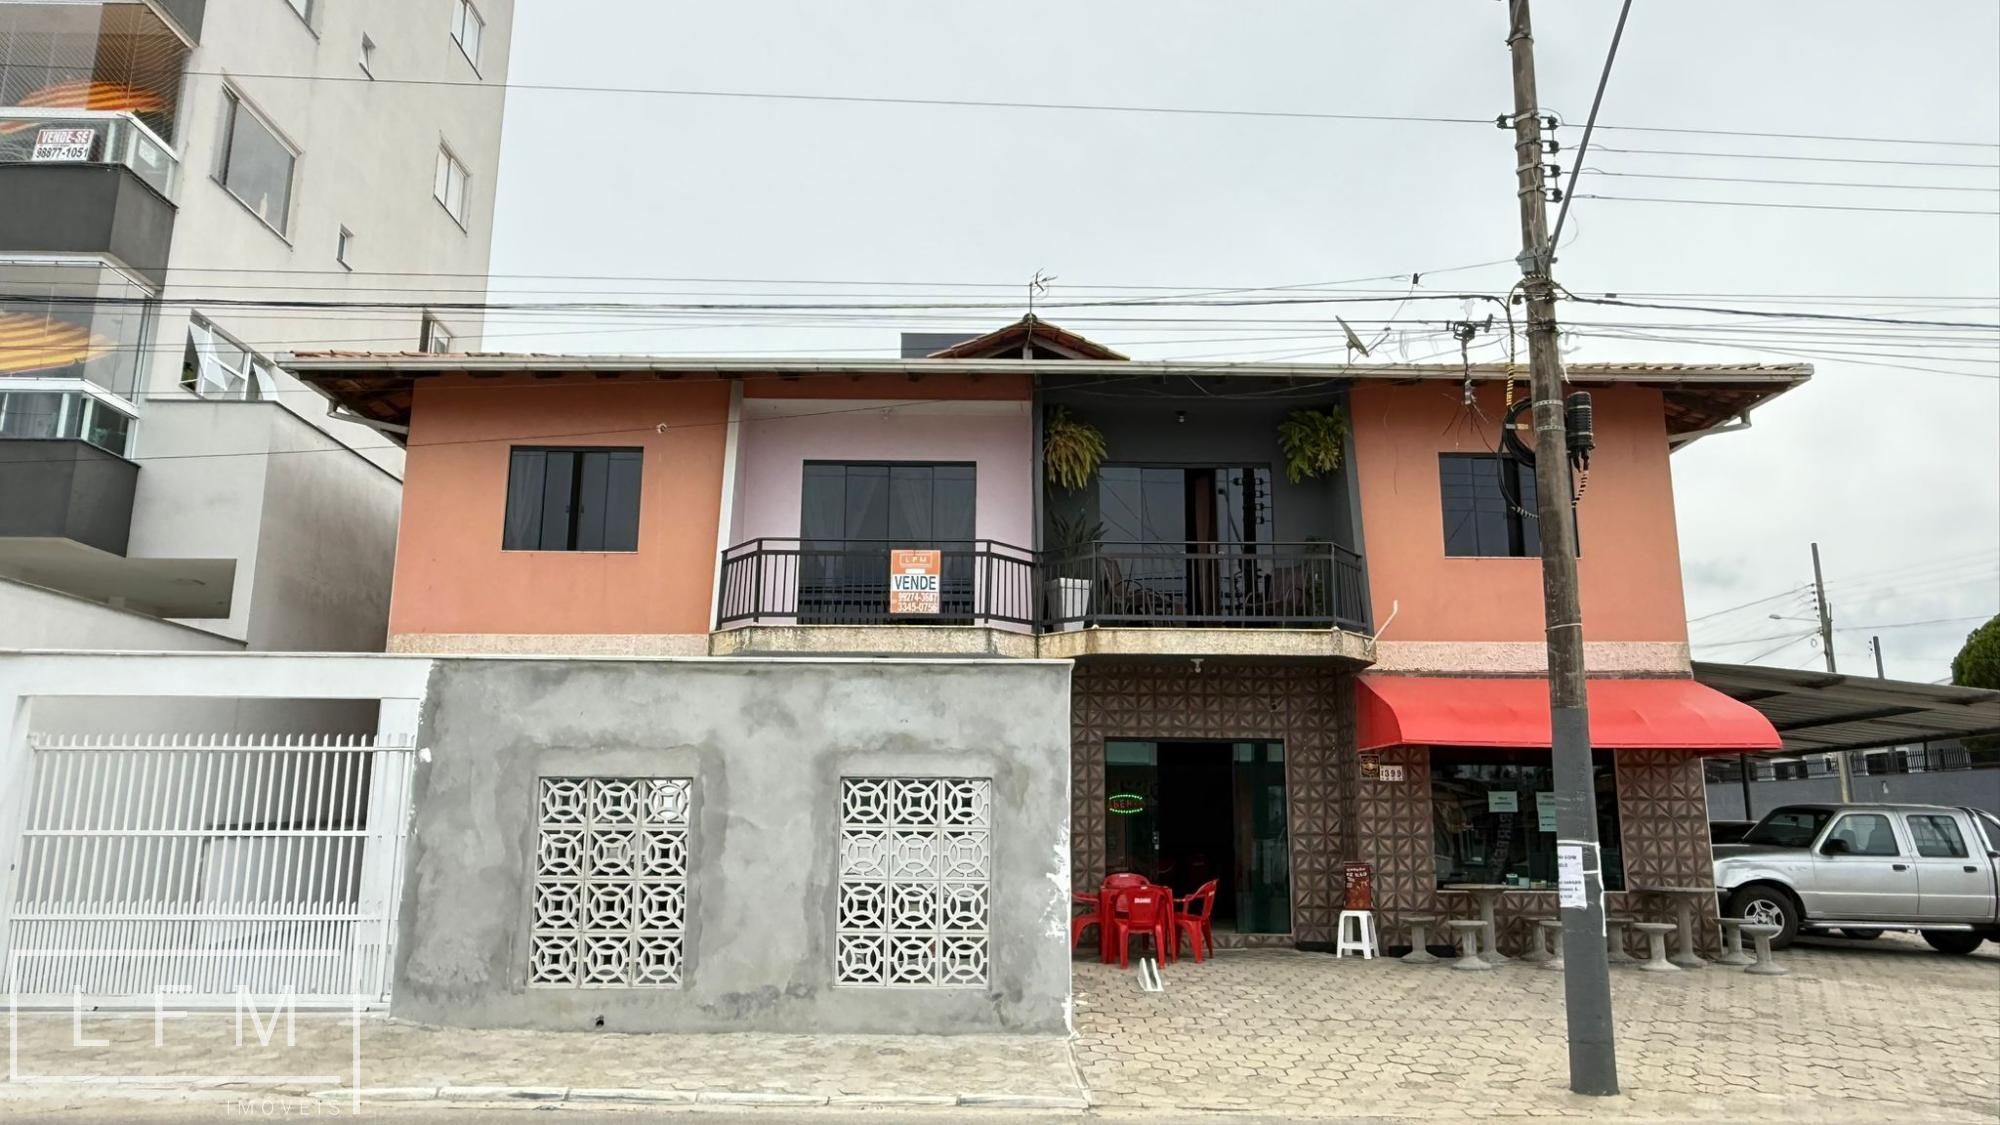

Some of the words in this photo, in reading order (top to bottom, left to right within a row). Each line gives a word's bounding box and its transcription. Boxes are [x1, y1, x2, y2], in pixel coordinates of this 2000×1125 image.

[42, 131, 90, 143] VENDE-SE
[36, 147, 89, 158] 98877-1051
[894, 575, 937, 590] VENDE
[1380, 768, 1402, 778] 1399
